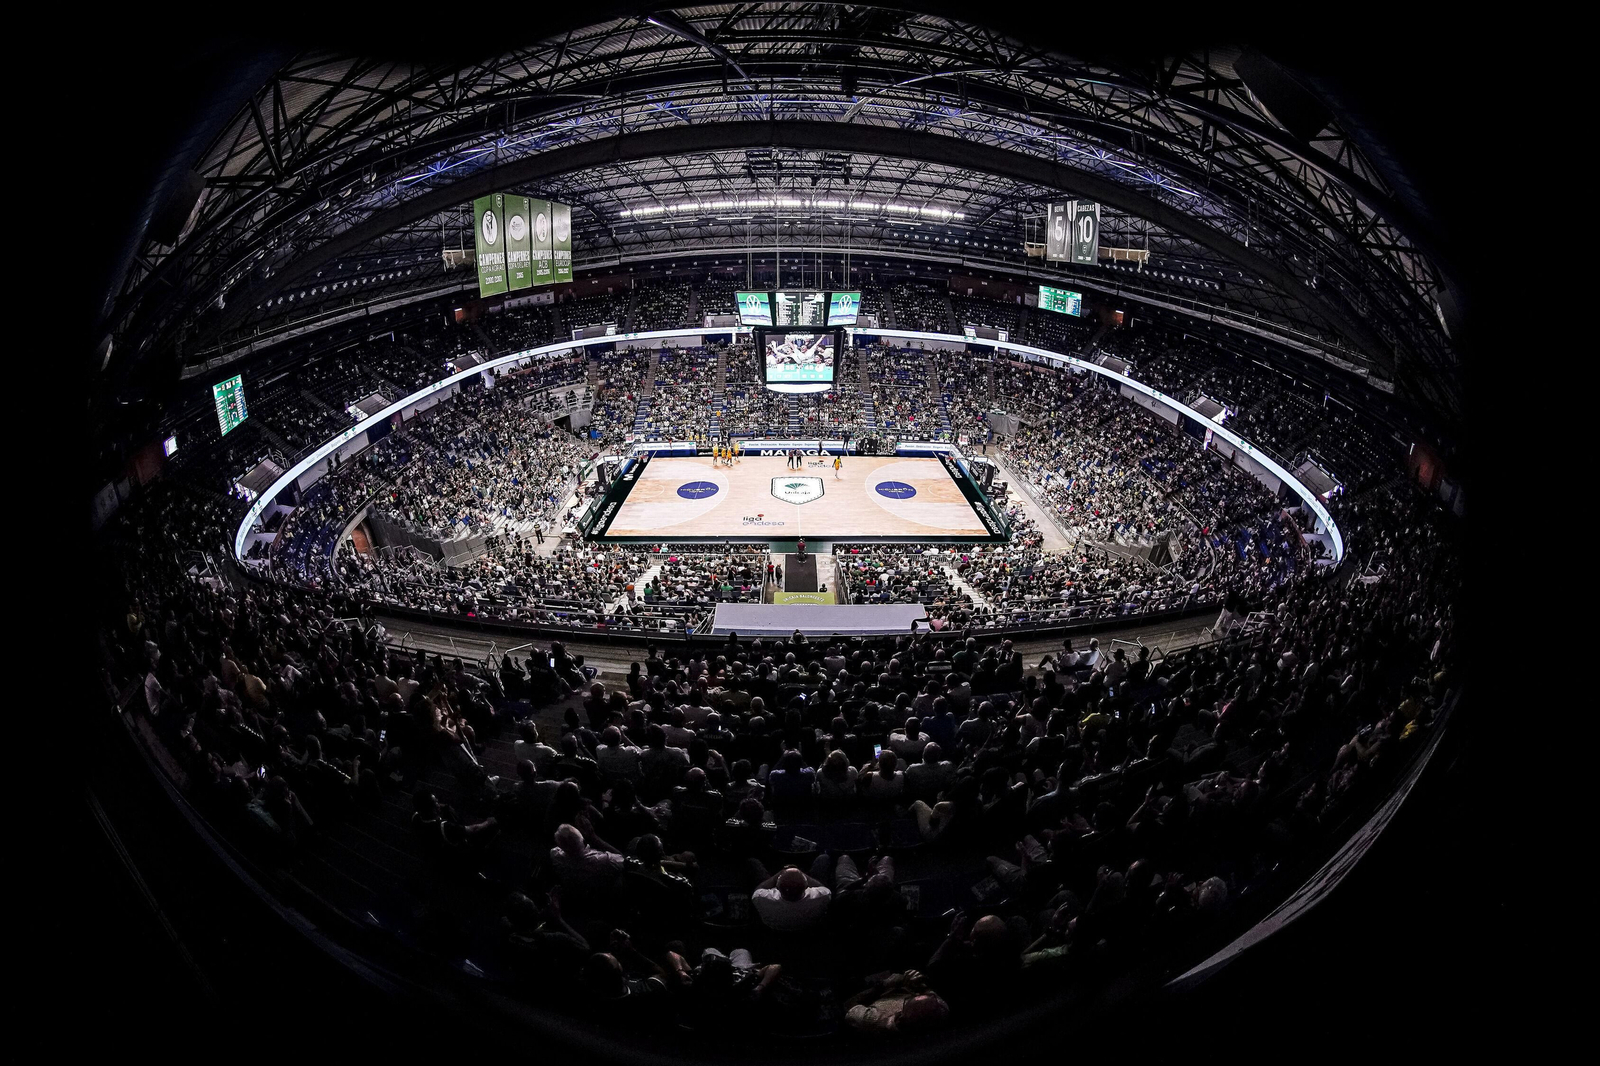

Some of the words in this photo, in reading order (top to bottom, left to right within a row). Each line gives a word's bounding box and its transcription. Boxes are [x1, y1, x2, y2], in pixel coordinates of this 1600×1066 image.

[1077, 204, 1095, 212] CABEZAS
[1054, 216, 1063, 242] 5
[1078, 216, 1093, 243] 10
[479, 253, 505, 266] CAMPEONES
[508, 250, 530, 262] CAMPEONES
[538, 260, 549, 269] ACB
